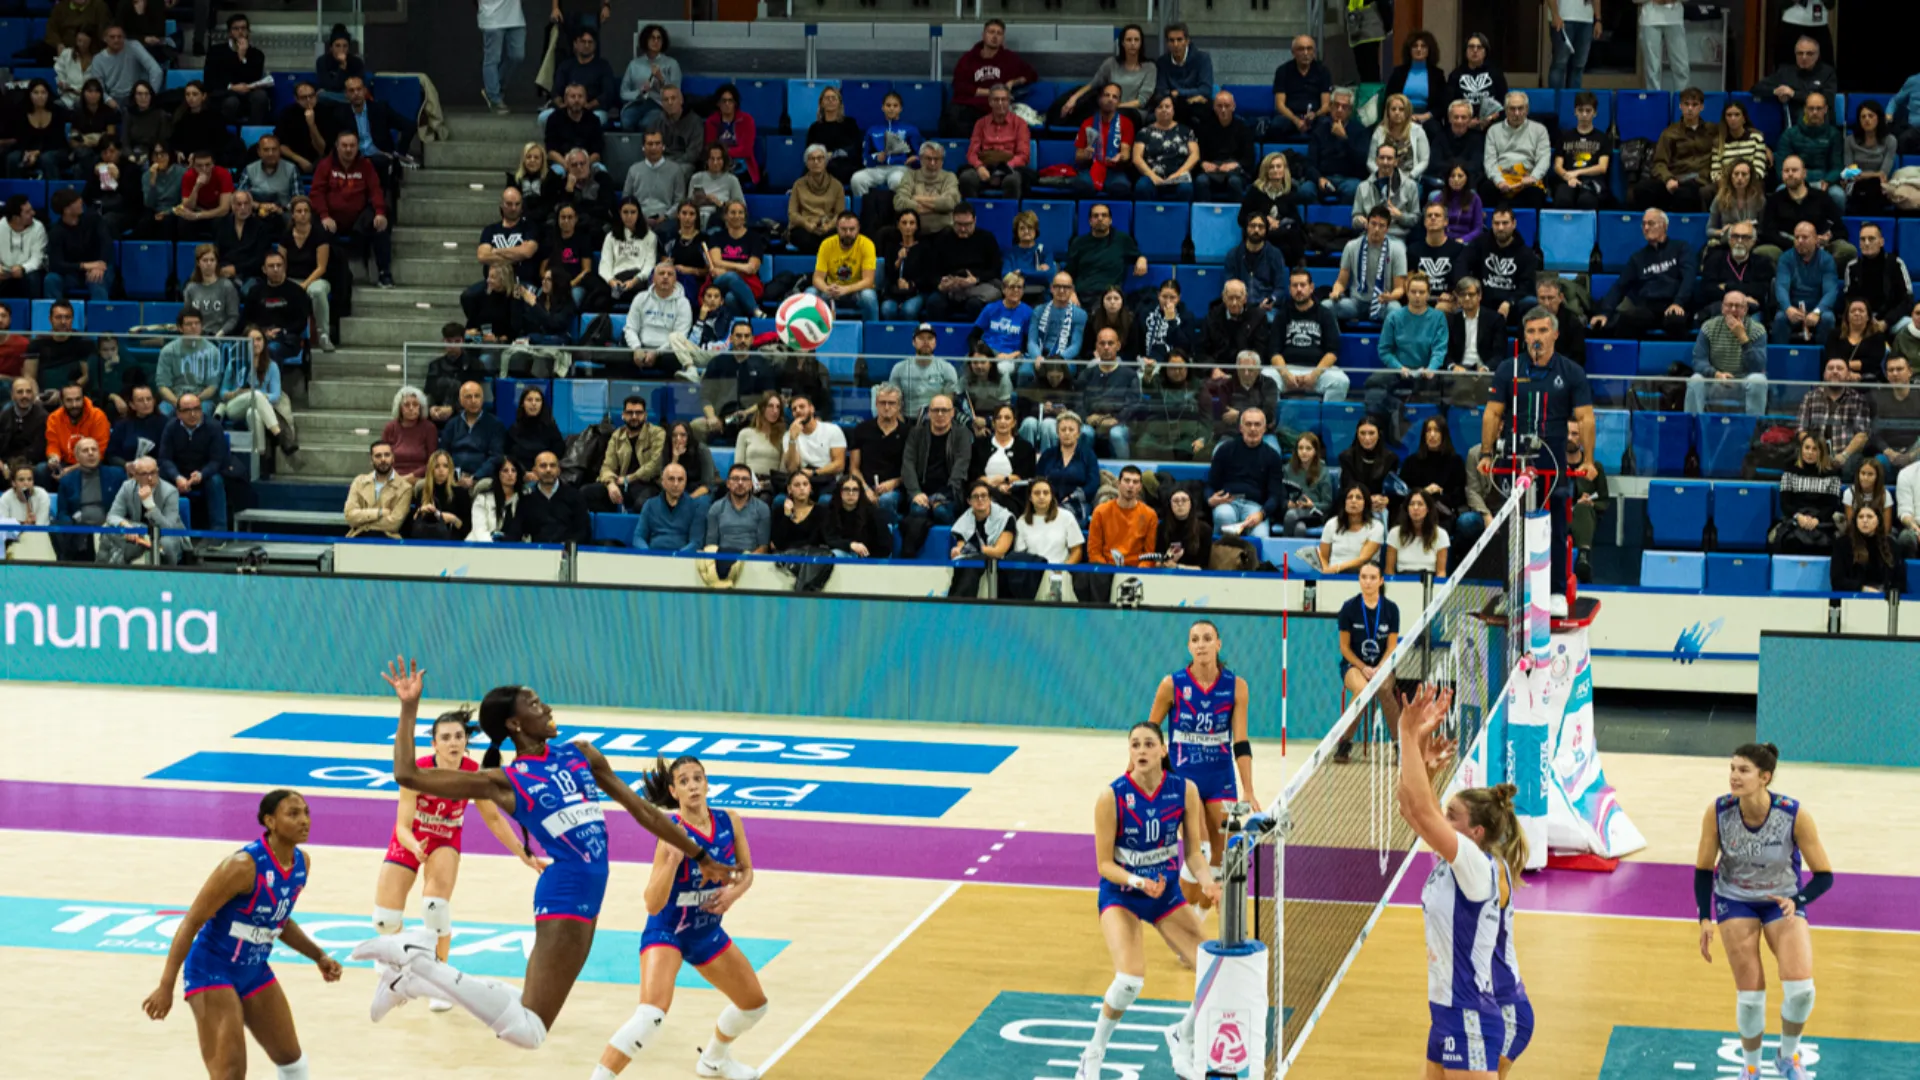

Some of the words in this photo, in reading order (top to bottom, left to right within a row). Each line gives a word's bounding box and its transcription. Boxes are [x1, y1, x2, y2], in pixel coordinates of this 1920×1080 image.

[192, 299, 221, 311] NYC
[5, 591, 218, 653] numia
[1196, 713, 1214, 732] 25
[550, 769, 578, 796] 18
[1145, 818, 1160, 843] 10
[270, 898, 290, 921] 16
[1444, 1036, 1456, 1052] 10
